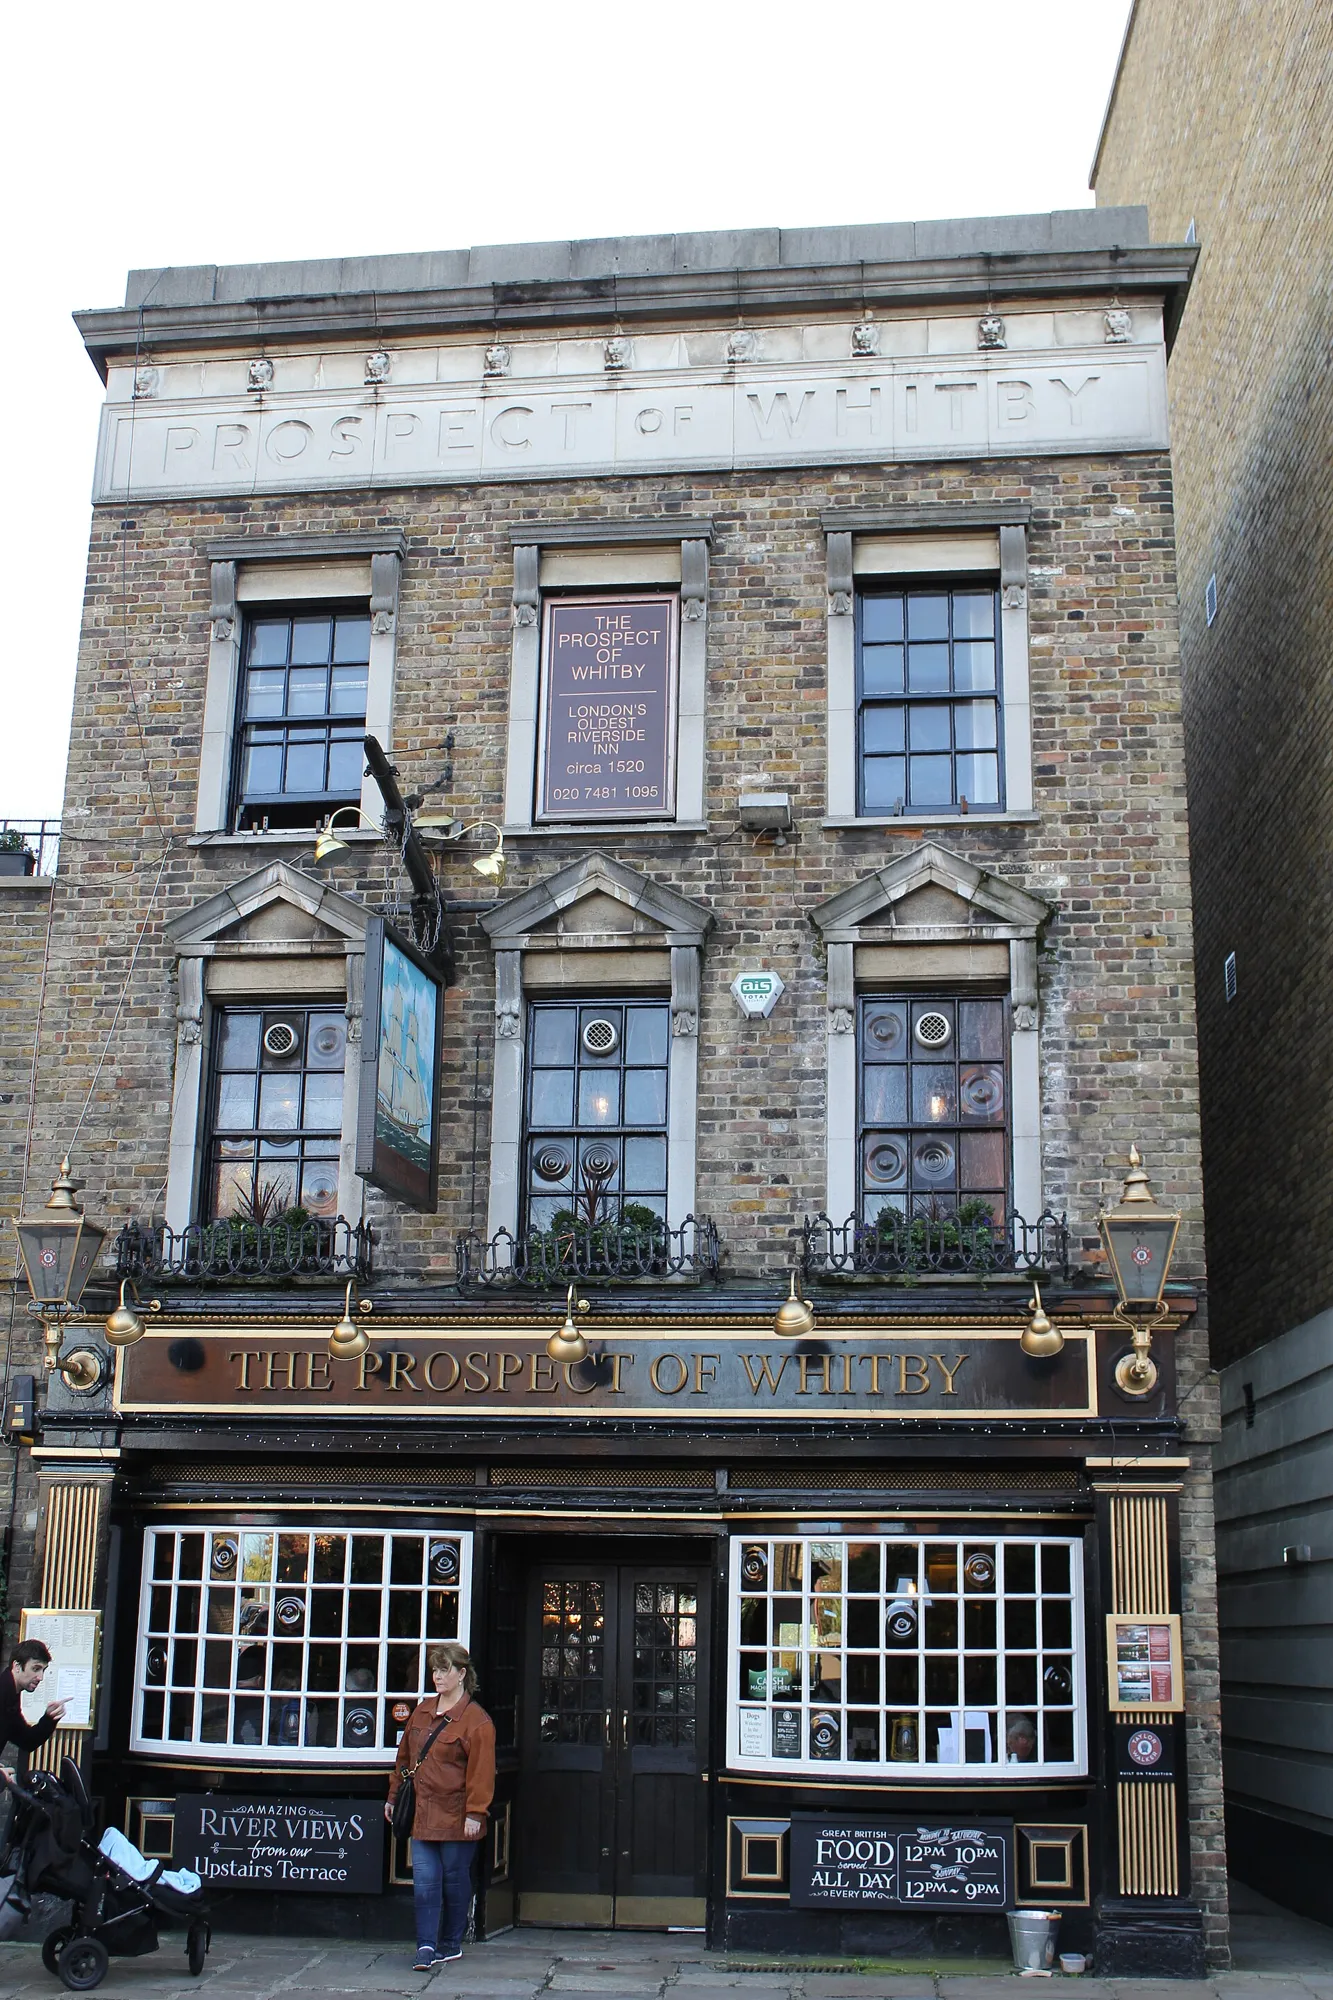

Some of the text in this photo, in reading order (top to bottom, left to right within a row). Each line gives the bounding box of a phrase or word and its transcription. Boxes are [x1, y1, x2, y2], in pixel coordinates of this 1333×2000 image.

[163, 376, 1100, 473] PROSPECT OF WHITBY
[595, 615, 631, 630] THE
[558, 630, 661, 648] PROSPECT
[596, 648, 622, 663] OF
[571, 663, 646, 680] WHITBY
[569, 703, 647, 718] LONDON'S
[577, 717, 636, 731] OLDEST
[567, 729, 645, 743] RIVERSIDE
[593, 743, 619, 755] INN
[566, 760, 645, 774] circa 1520
[553, 785, 658, 800] 020 7481 1095
[229, 1350, 970, 1395] THE PROSPECT OF WHITBY
[746, 1712, 760, 1720] Dogs
[1131, 1733, 1157, 1744] TAYLOR
[1132, 1750, 1158, 1762] WALKER
[247, 1805, 307, 1815] AMAZING
[200, 1808, 364, 1841] RIVER VIEWS
[822, 1830, 887, 1838] GREAT BRITISH
[247, 1840, 312, 1859] from our
[816, 1839, 895, 1867] FOOD
[905, 1845, 998, 1864] 12PM 10PM
[195, 1857, 347, 1881] Upstairs Terrace
[837, 1860, 868, 1870] served
[811, 1871, 896, 1889] ALL DAY
[830, 1890, 879, 1899] EVERY DAY
[964, 1883, 1000, 1899] 9PM
